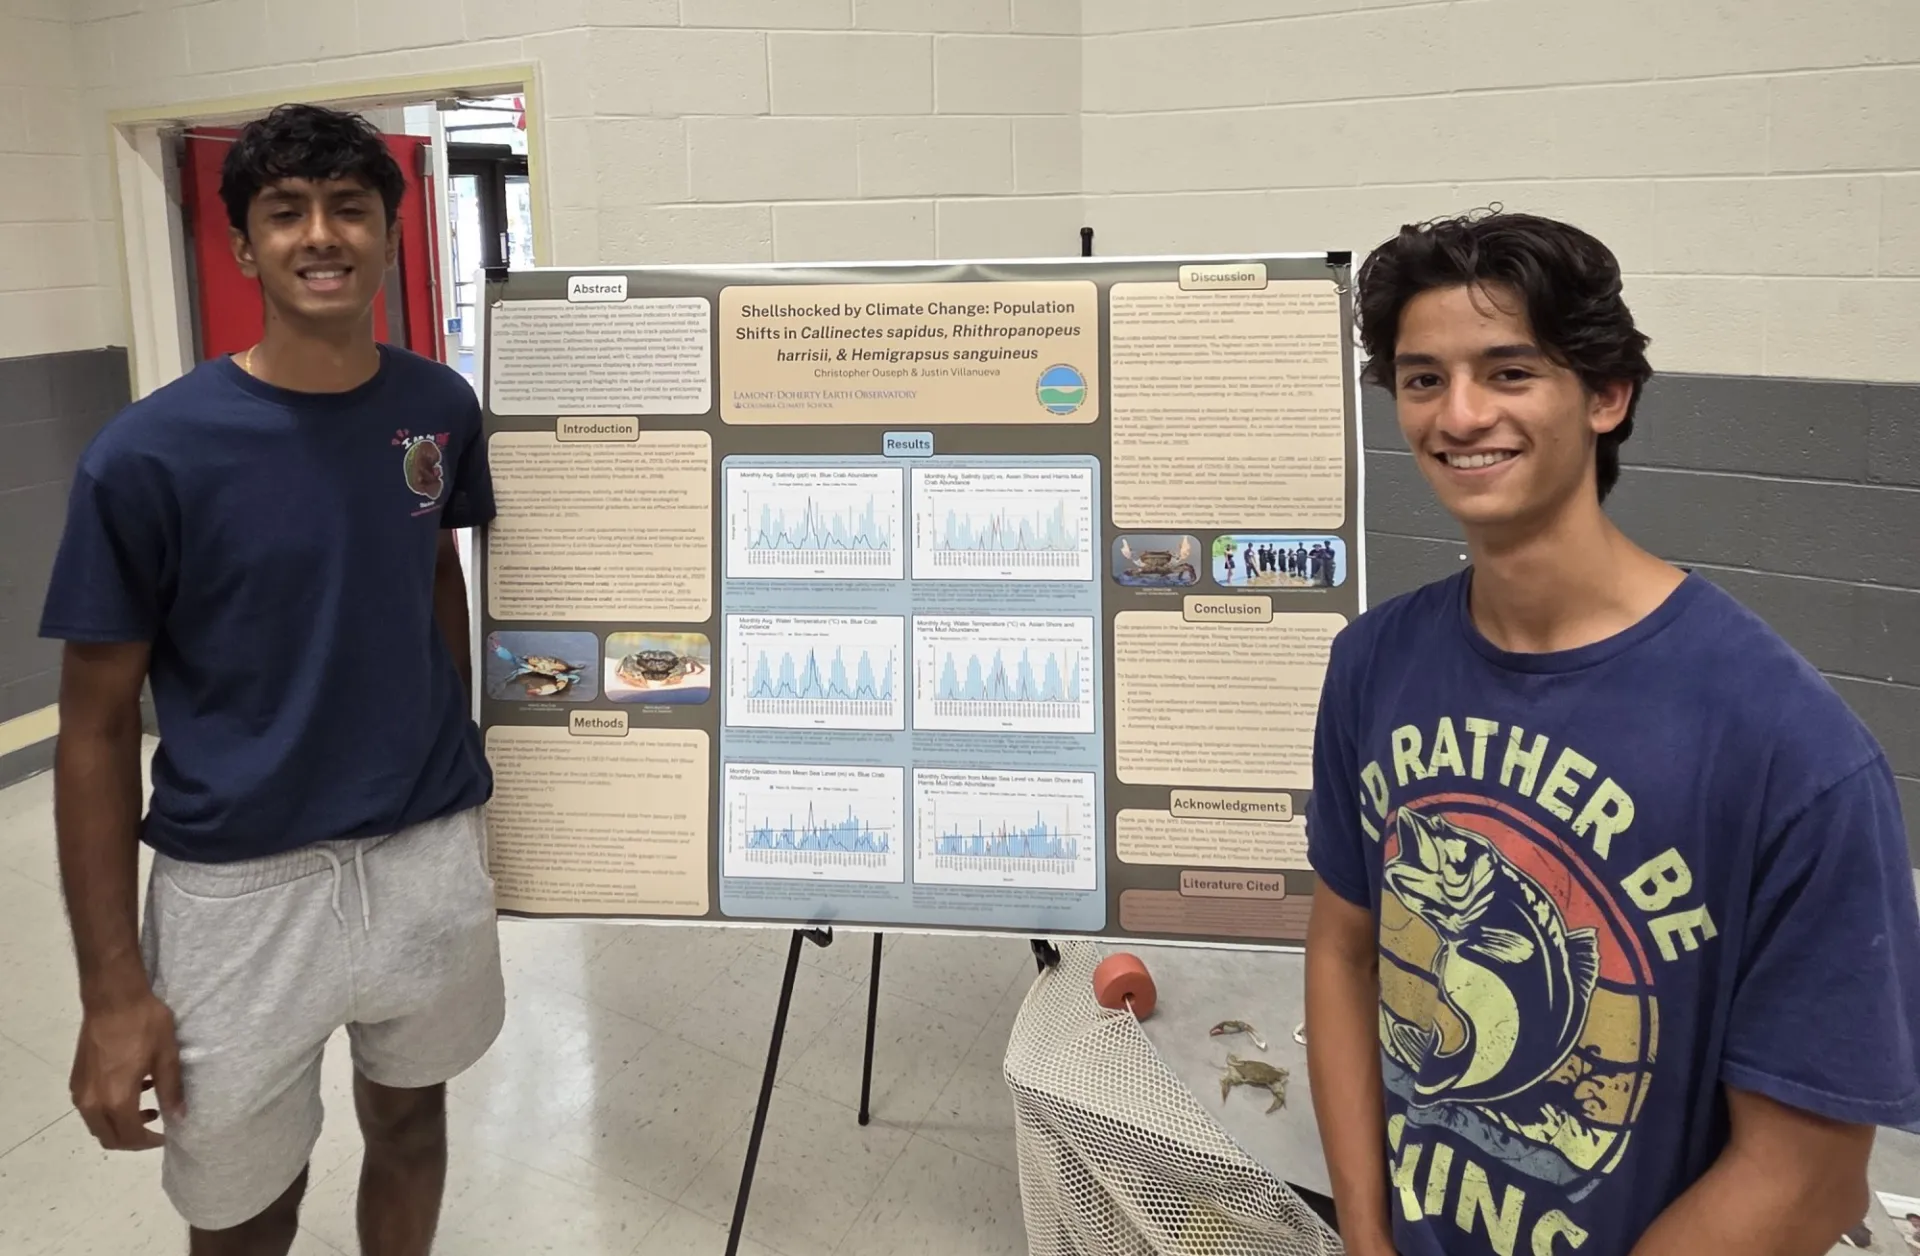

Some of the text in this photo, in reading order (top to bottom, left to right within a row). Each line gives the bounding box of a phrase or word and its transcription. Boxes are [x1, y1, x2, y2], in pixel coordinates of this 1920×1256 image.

[1191, 272, 1255, 283] Discussion
[573, 284, 622, 294] Abstract
[741, 300, 1074, 318] Shellshocked by Climate Change: Population
[736, 324, 1080, 340] Shifts in Callinectes sapidus, Rhithropanopeus
[777, 346, 1038, 363] harrisii, & Hemigrapsus sanguineus
[814, 367, 1000, 378] Christopher Ouseph & Justin Villanueva
[733, 389, 917, 400] LAMONT-DOHERTY EARTH OBSERVATORY
[564, 424, 632, 433] Introduction
[887, 439, 930, 450] Results
[1194, 603, 1261, 614] Conclusion
[575, 718, 624, 728] Methods
[1174, 798, 1286, 813] Acknowledgments
[1392, 717, 1635, 861] RATHER
[1620, 848, 1720, 962] BE
[1183, 878, 1279, 891] Literature Cited
